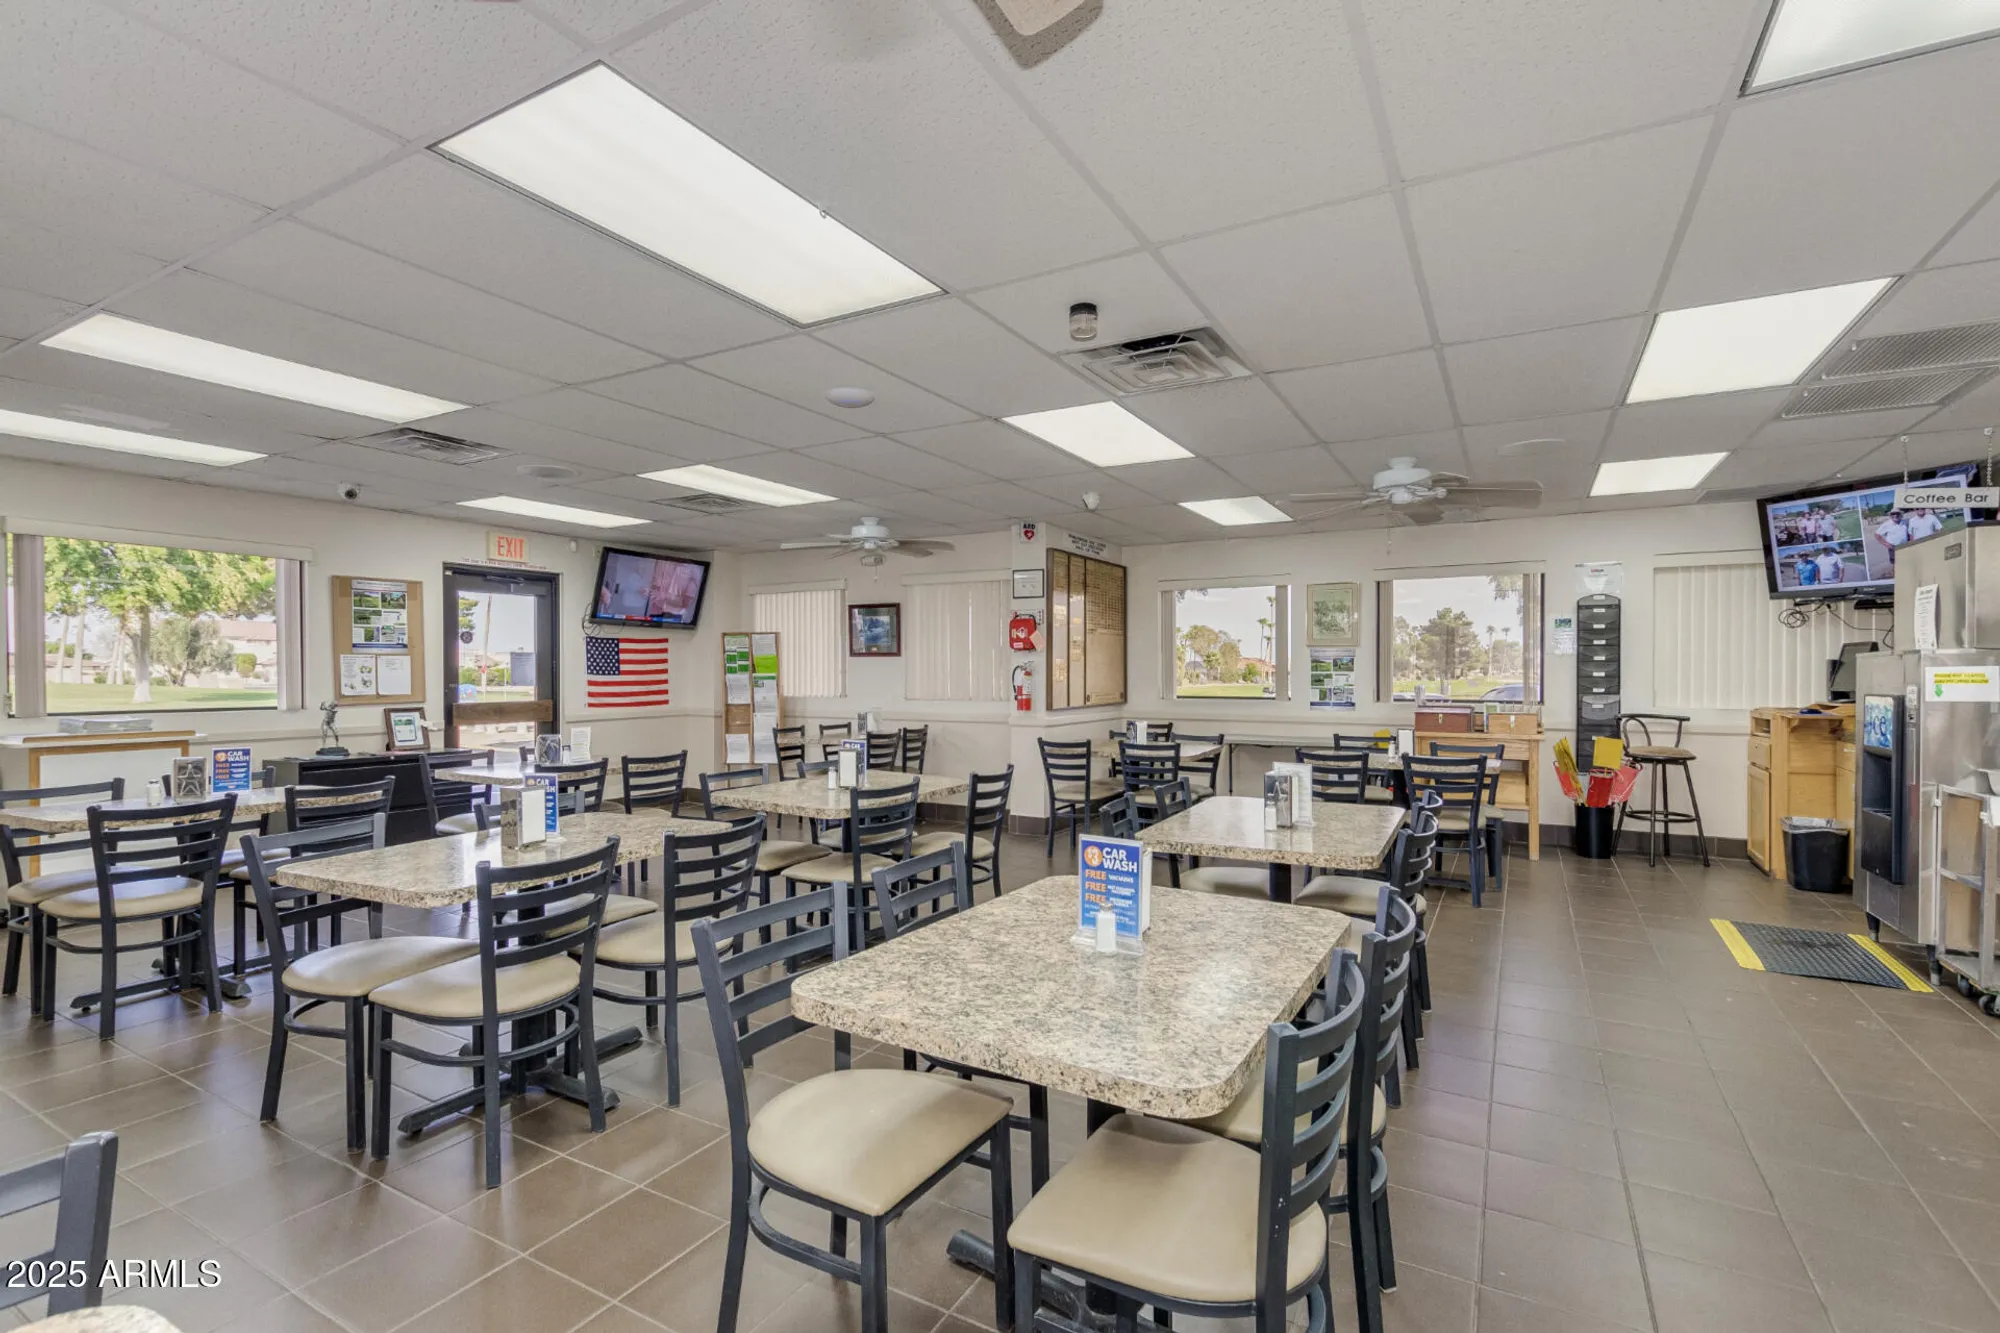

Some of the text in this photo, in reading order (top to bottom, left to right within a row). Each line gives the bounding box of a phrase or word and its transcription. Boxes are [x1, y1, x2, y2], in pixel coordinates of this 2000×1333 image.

[1903, 493, 1989, 504] Coffee Bar
[497, 536, 524, 560] EXIT
[1102, 847, 1127, 860] CAR
[1103, 858, 1138, 873] WASH
[1085, 869, 1106, 880] FREE
[1085, 881, 1106, 892] FREE
[1085, 893, 1106, 904] FREE
